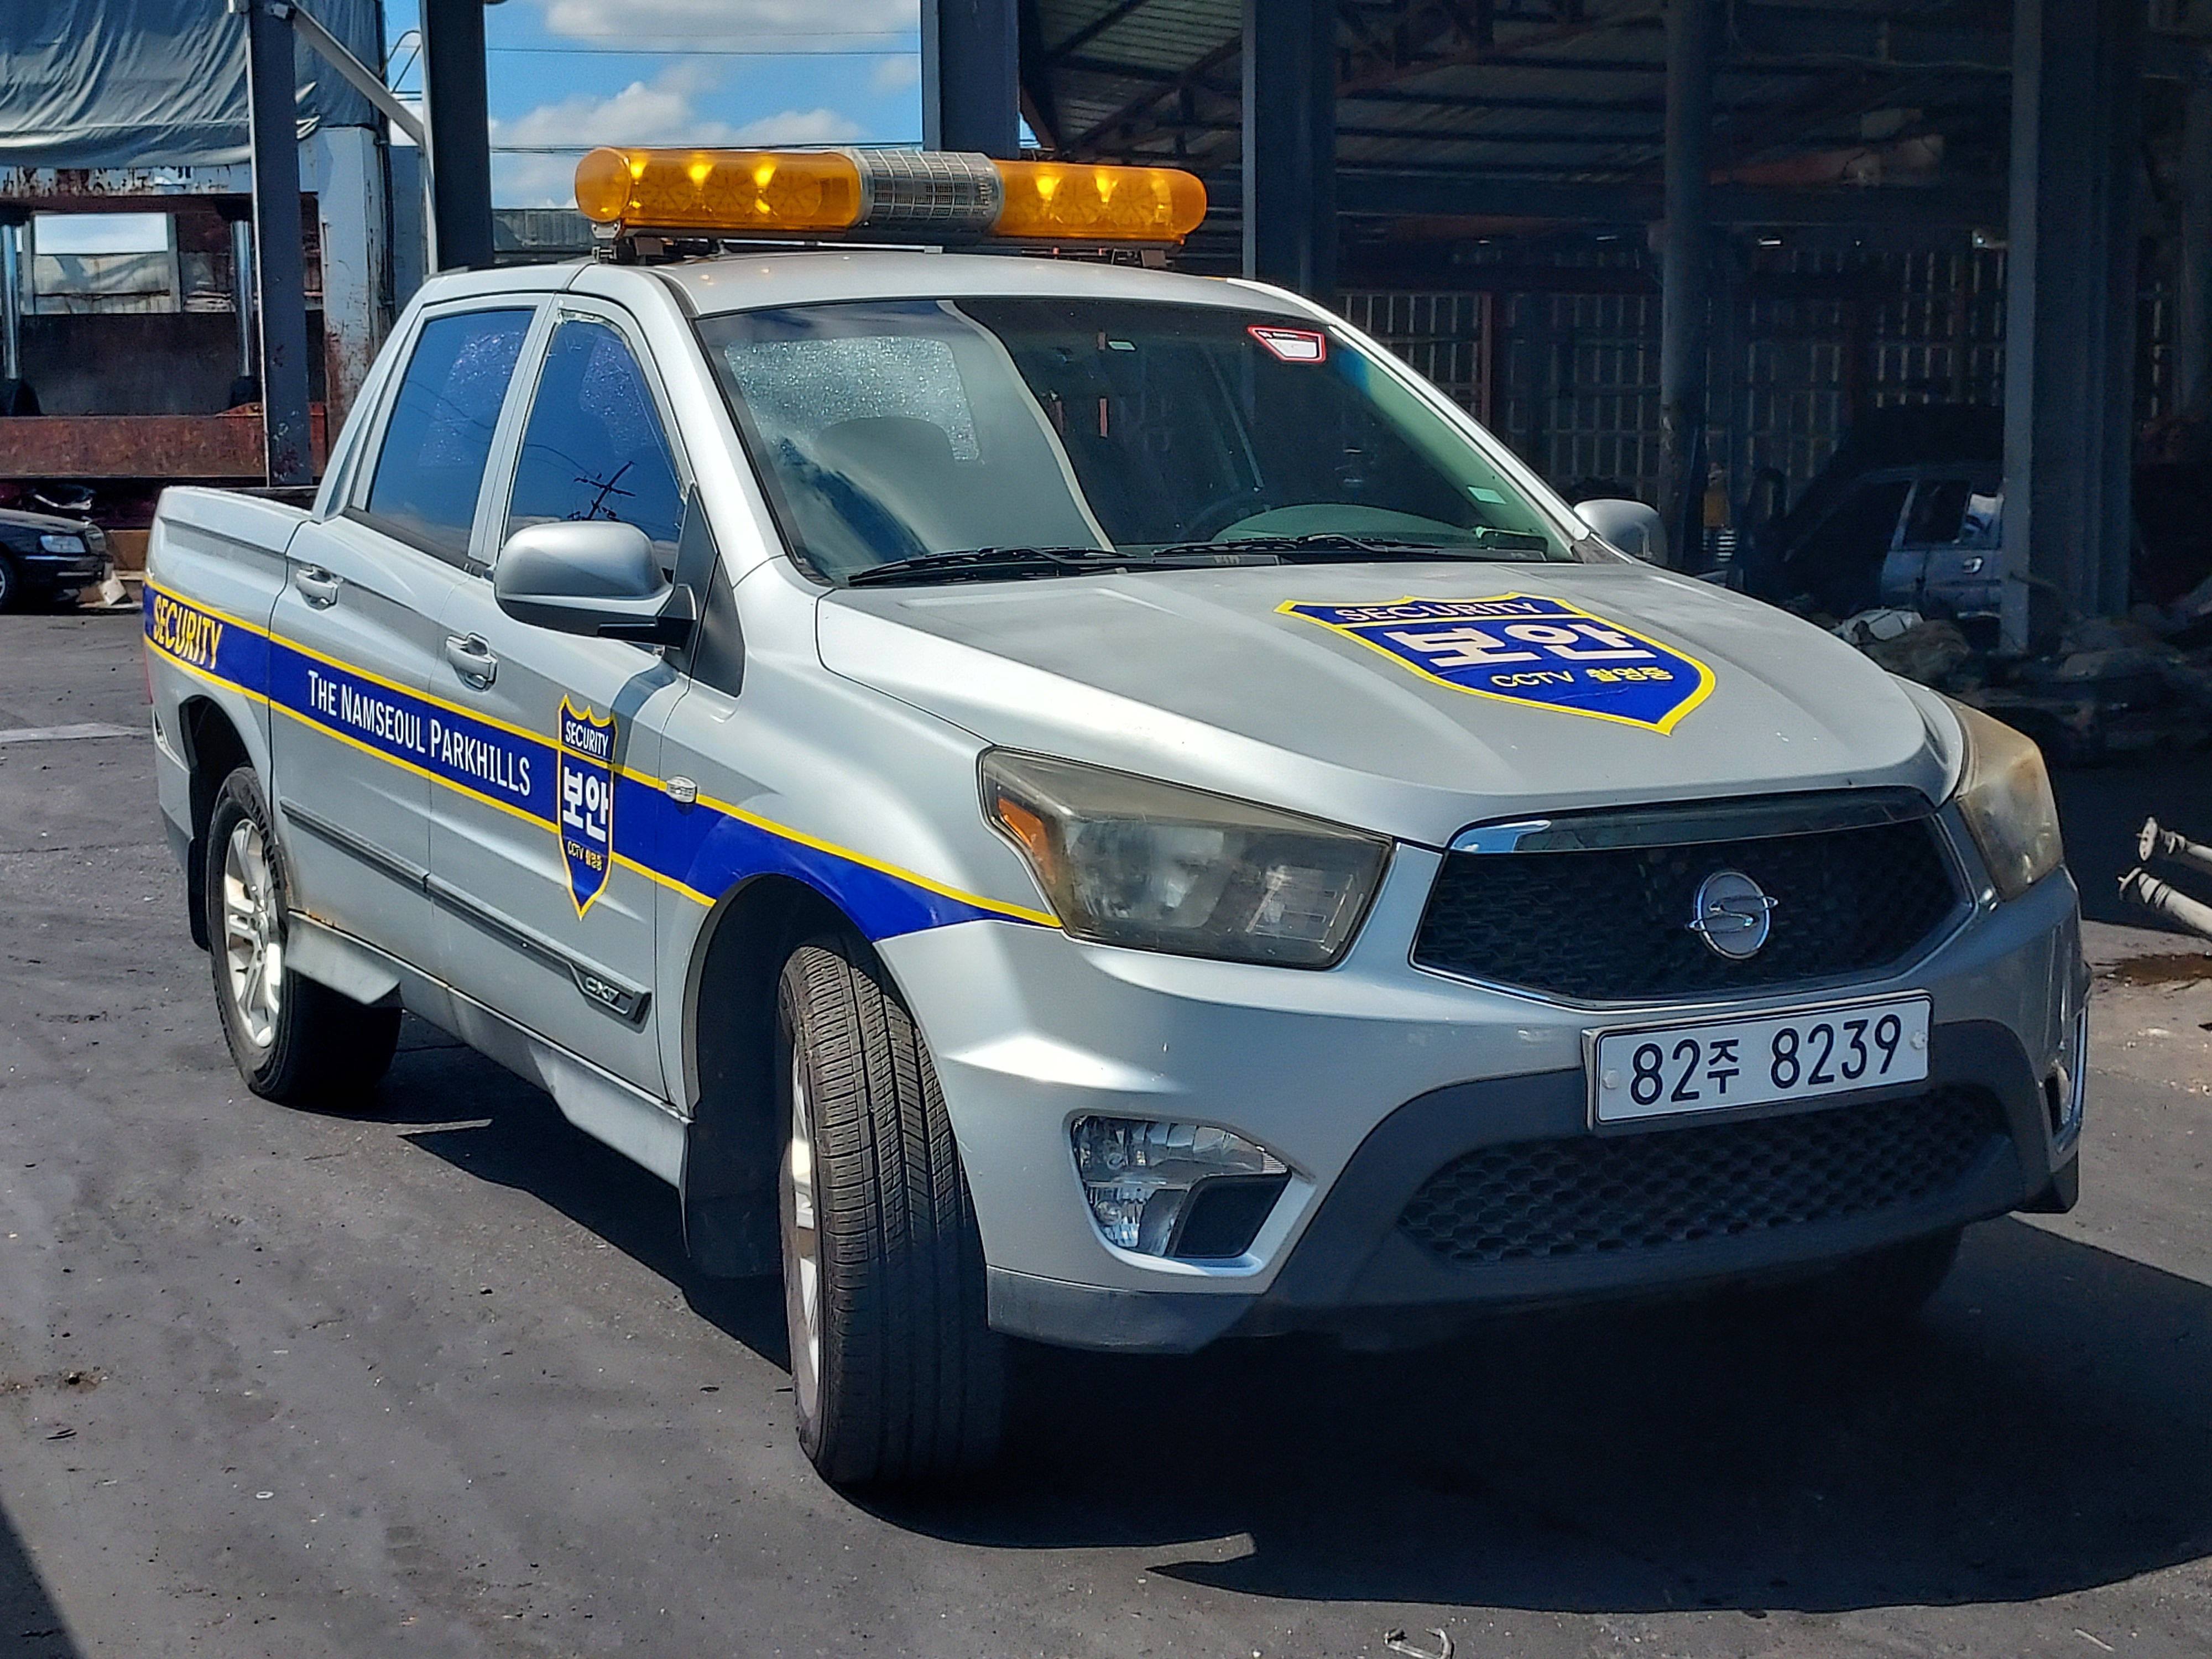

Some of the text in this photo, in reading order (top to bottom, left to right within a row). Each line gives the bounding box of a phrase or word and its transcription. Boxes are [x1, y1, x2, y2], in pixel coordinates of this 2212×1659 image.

[153, 594, 223, 670] SECURITY
[1334, 600, 1543, 623] SECURITY
[1384, 623, 1657, 667] 보안
[1491, 671, 1574, 687] CCTV
[307, 670, 531, 797] THE NAMSEOUL PARKHILLS
[565, 721, 609, 757] SECURITY
[563, 766, 609, 843] 보안
[567, 841, 584, 860] CCTV
[1630, 1014, 1901, 1105] 82주 8239
